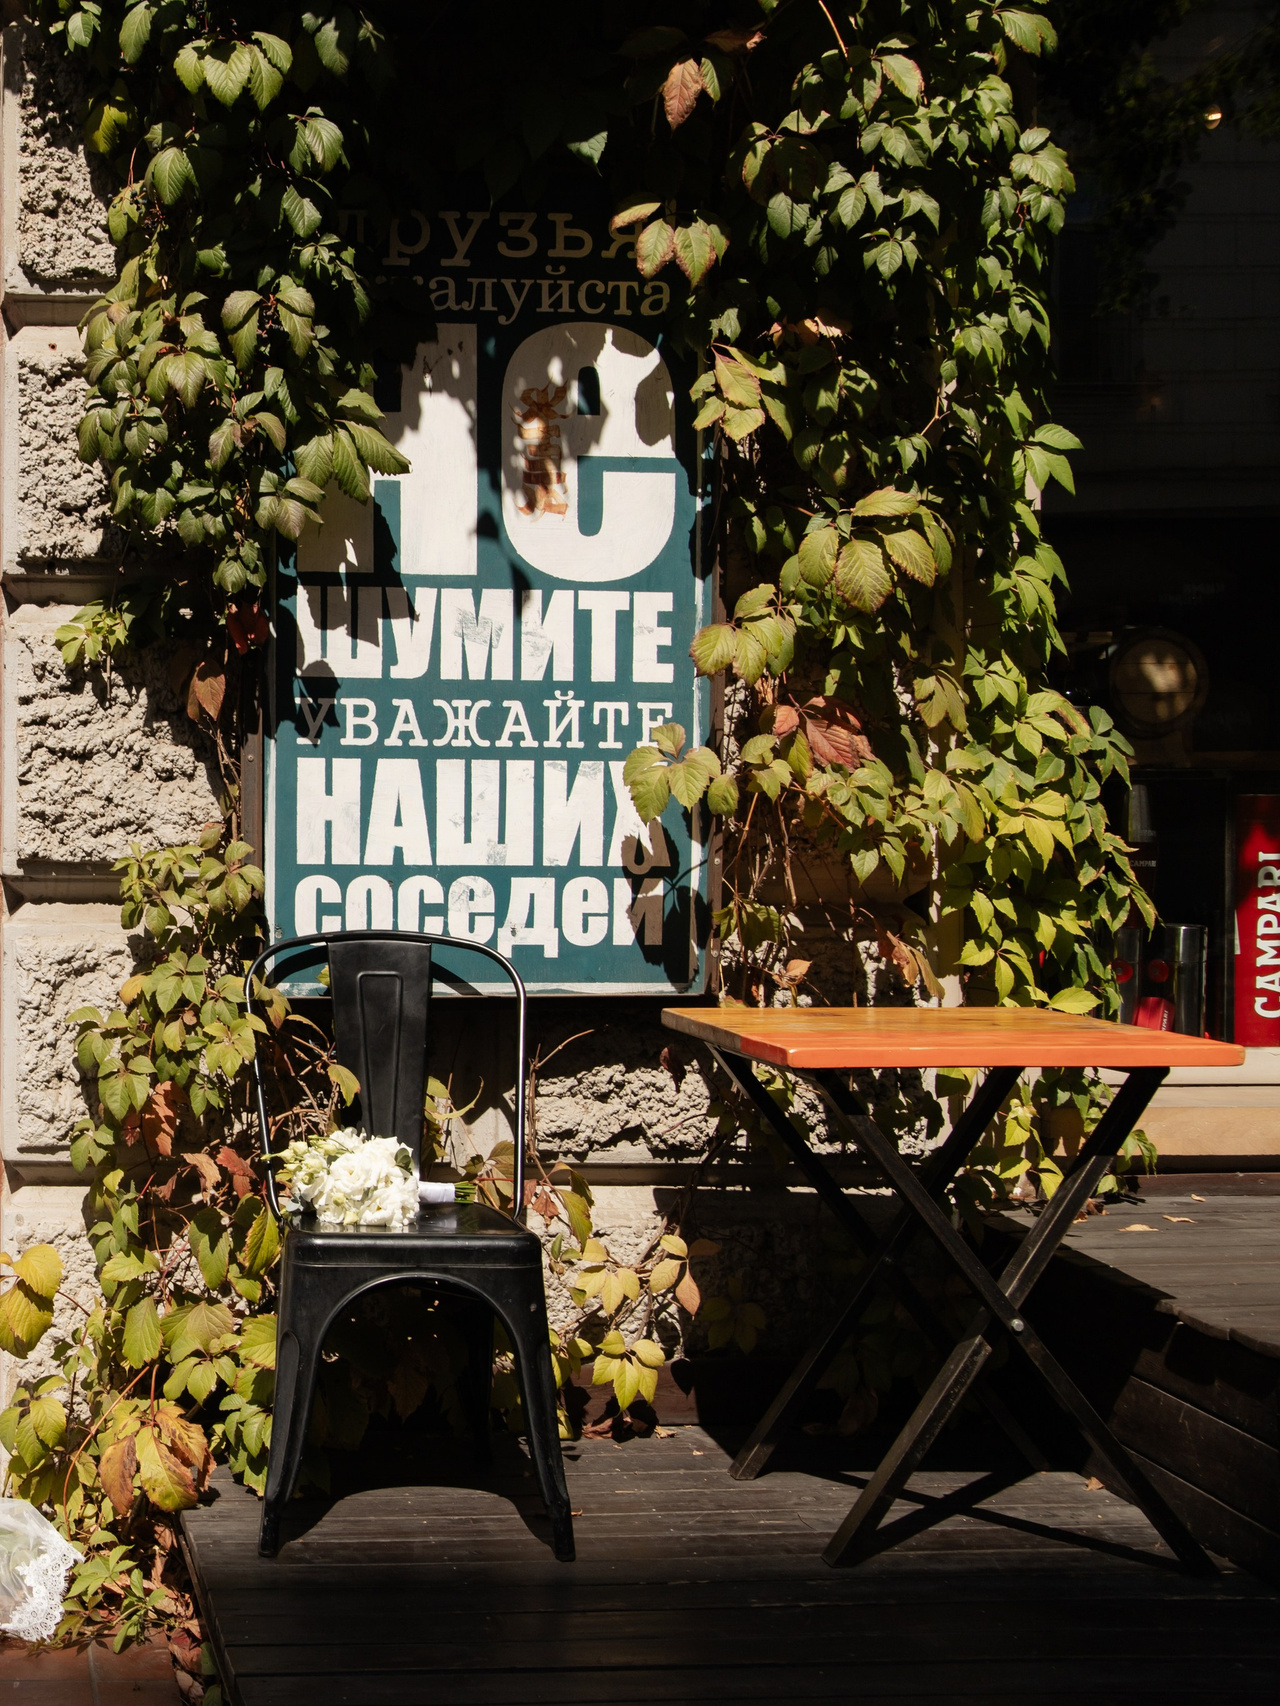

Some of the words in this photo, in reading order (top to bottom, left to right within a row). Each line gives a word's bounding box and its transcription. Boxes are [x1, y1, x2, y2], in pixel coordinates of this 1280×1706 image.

[375, 264, 671, 326] алуйста
[296, 585, 674, 683] ШУМИТЕ
[295, 690, 673, 749] УВАЖАЙТЕ
